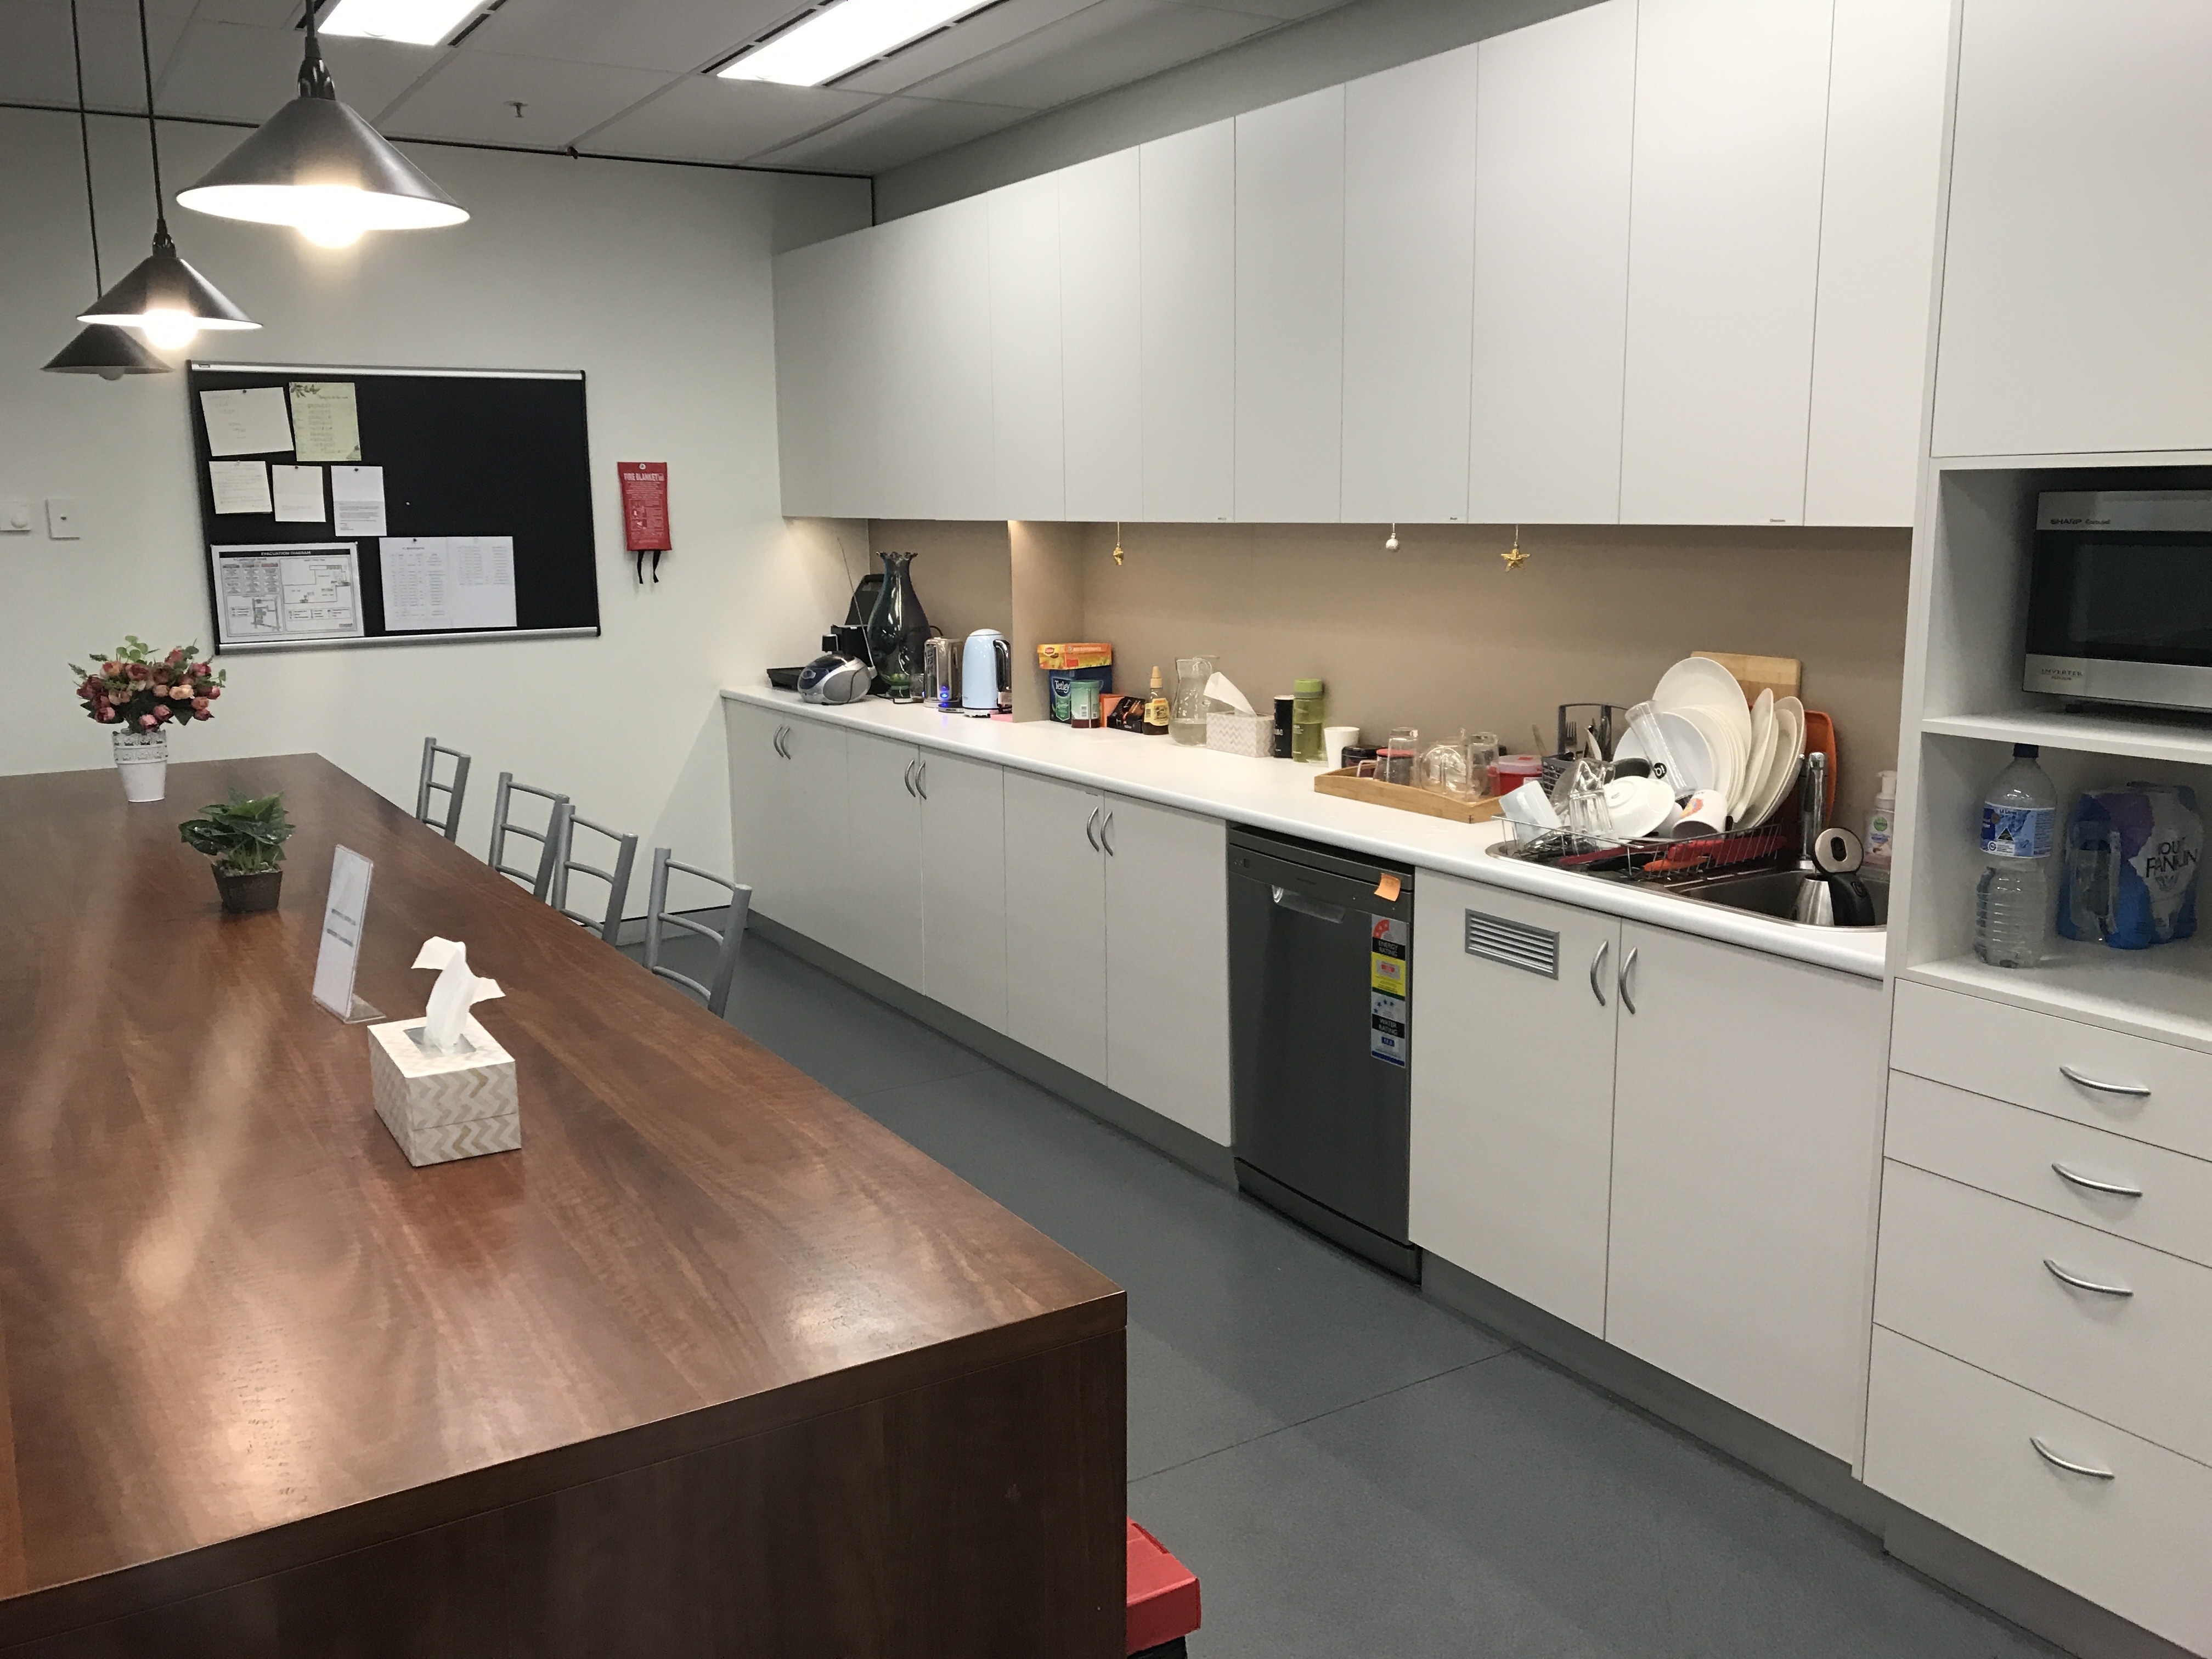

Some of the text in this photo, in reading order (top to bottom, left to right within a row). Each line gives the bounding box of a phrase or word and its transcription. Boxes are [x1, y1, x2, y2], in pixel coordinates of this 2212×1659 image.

[1054, 680, 1070, 693] Tetley
[1378, 940, 1398, 951] ENERGY
[1379, 946, 1398, 957] RATING
[1379, 1018, 1397, 1029] WATER
[1379, 1024, 1398, 1035] RATING
